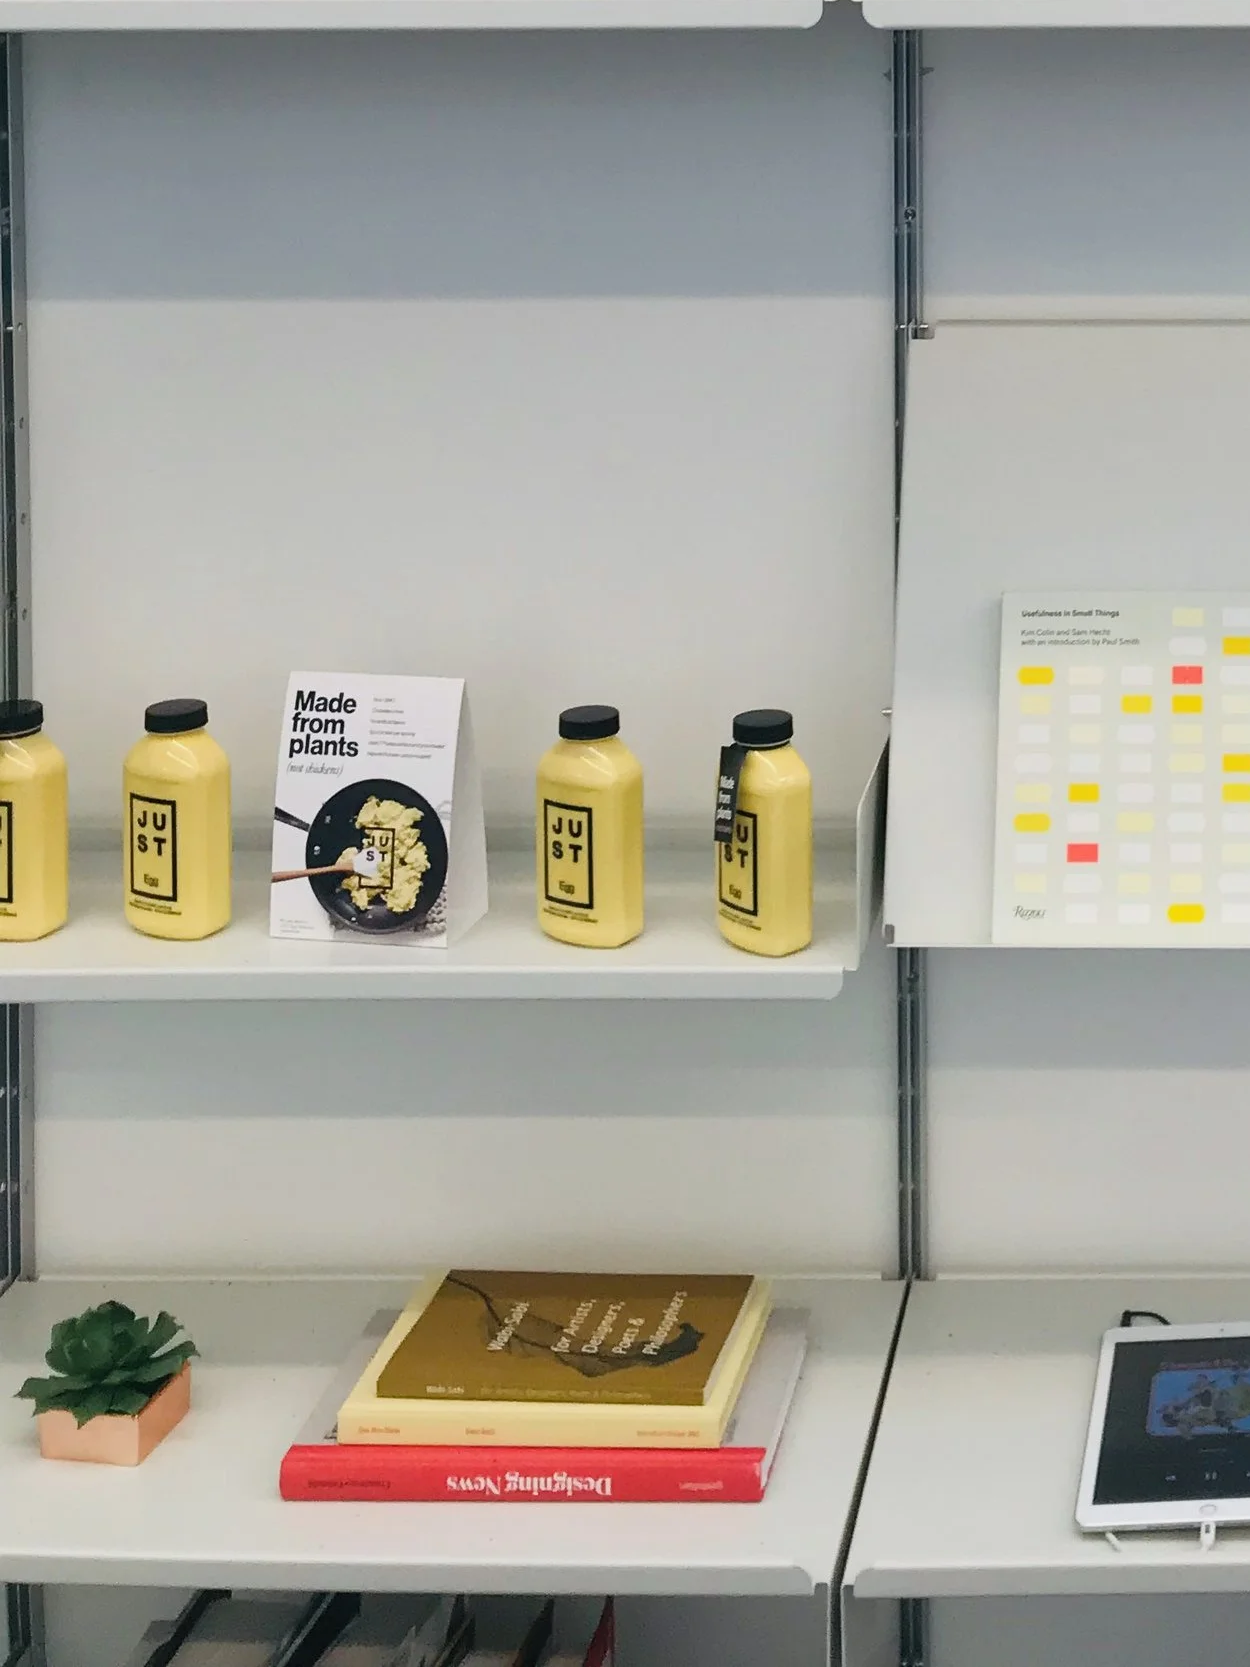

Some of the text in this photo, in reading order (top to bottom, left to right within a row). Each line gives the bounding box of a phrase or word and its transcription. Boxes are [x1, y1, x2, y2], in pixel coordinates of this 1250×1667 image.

[1021, 609, 1120, 619] Usefulness in Small Things
[1056, 628, 1070, 636] and
[1091, 638, 1100, 647] by
[1119, 637, 1140, 645] Smith
[294, 689, 357, 714] Made
[292, 711, 345, 735] from
[288, 733, 359, 759] plants
[143, 873, 159, 888] Egg
[558, 880, 575, 895] Egg
[728, 884, 742, 900] Egg
[550, 1299, 598, 1354] for Artists,
[580, 1300, 626, 1354] Designers,
[641, 1289, 689, 1356] Philosophers
[611, 1316, 645, 1355] Poets &
[446, 1471, 613, 1497] Designing News
